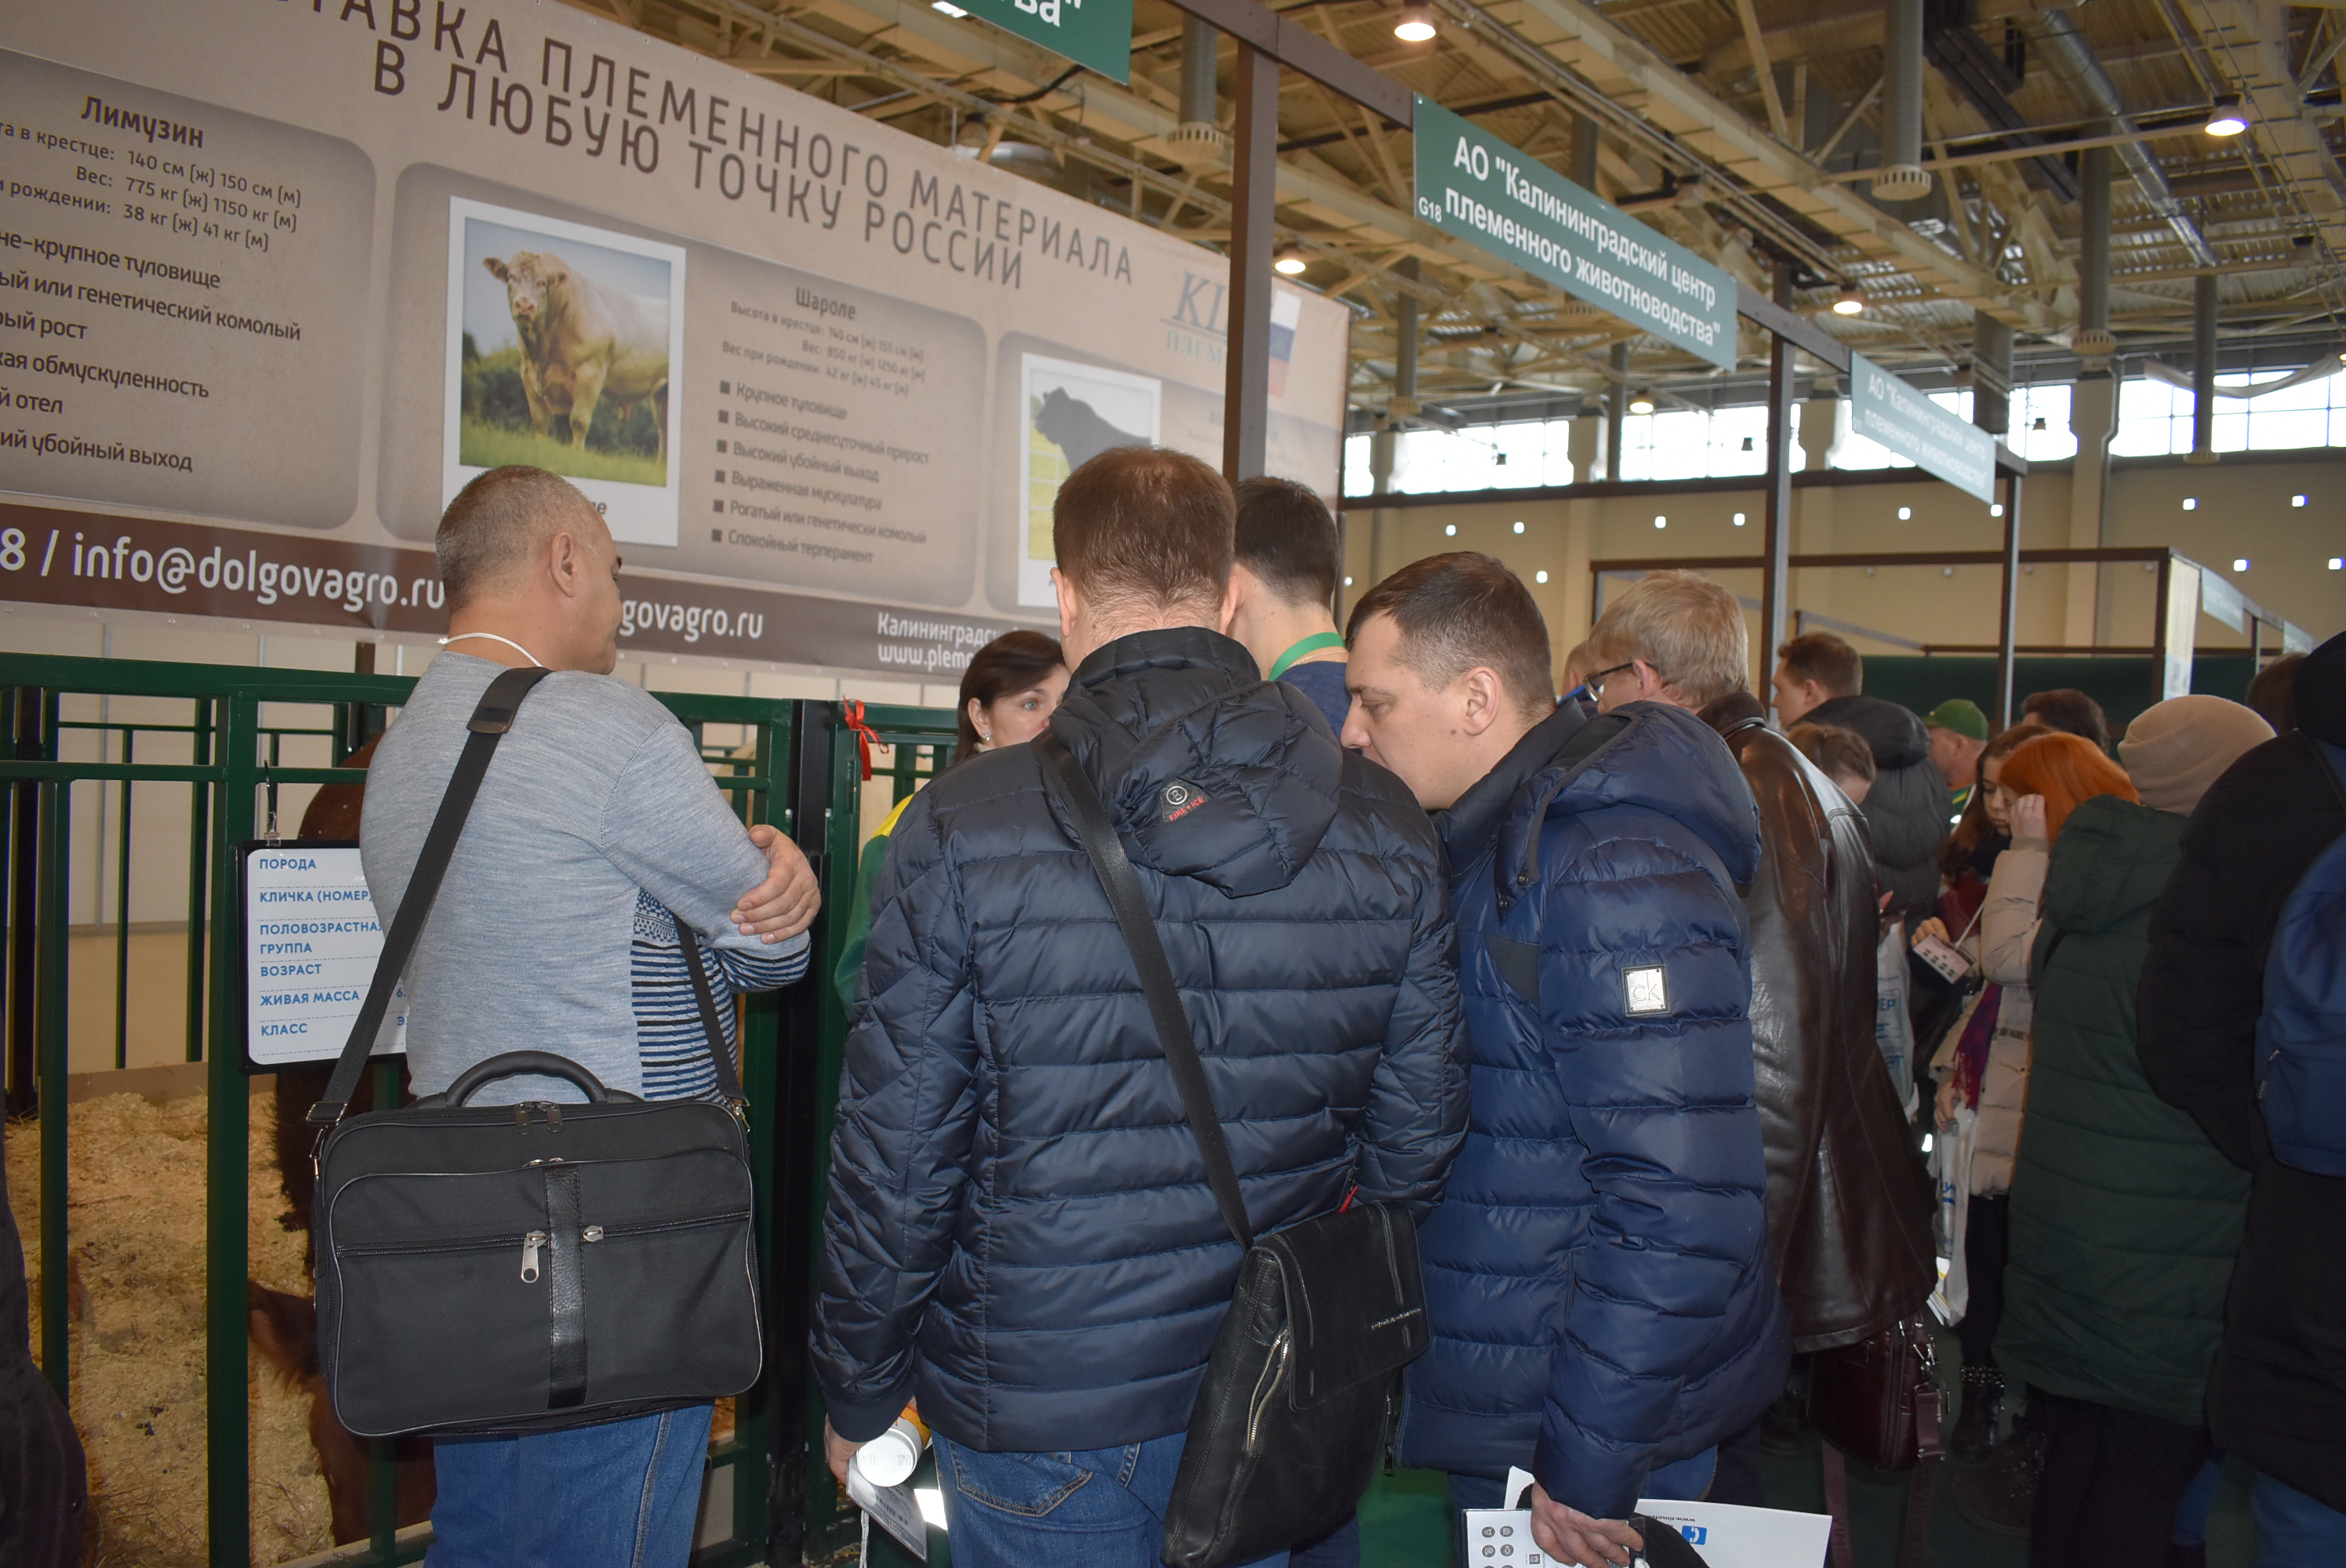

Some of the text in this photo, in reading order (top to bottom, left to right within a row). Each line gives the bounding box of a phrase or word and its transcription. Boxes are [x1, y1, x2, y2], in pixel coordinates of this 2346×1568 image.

[81, 96, 204, 148] Лимузин
[20, 128, 31, 140] в
[37, 132, 114, 160] крестце:
[128, 151, 158, 169] 140
[163, 162, 184, 177] см
[220, 173, 247, 191] 150
[252, 183, 272, 198] см
[374, 39, 1022, 289] В ЛЮБУЮ ТОЧКУ РОССИИ
[541, 37, 888, 197] ПЛЕМЕННОГО
[910, 169, 1131, 285] МАТЕРИАЛА
[76, 165, 113, 187] Вес:
[125, 176, 155, 197] 775
[160, 187, 178, 201] кг
[213, 198, 248, 218] 1150
[252, 209, 269, 223] кг
[1418, 196, 1442, 223] G18
[10, 182, 111, 215] рождении:
[123, 204, 145, 221] 38
[151, 212, 168, 226] кг
[203, 222, 220, 238] 41
[224, 229, 241, 242] кг
[1453, 135, 1716, 311] АО "Калининградский центр
[124, 255, 221, 289] туловище
[1445, 187, 1720, 347] племенного животноводства"
[34, 278, 73, 299] или
[78, 285, 212, 325] генетический
[216, 311, 301, 341] комолый
[796, 286, 856, 320] Шароле
[40, 318, 88, 339] рост
[32, 354, 209, 398] обмускуленность
[16, 394, 64, 414] отел
[736, 382, 788, 408] Крупное
[735, 411, 788, 437] Высокий
[32, 433, 125, 462] убойный
[129, 447, 193, 473] выход
[733, 441, 787, 465] Высокий
[730, 499, 781, 523] Рогатый
[0, 528, 445, 613] 8 / info@dolgovagro.ru
[260, 858, 316, 871] ПОРОДА
[260, 891, 314, 902] КЛИЧКА
[260, 942, 312, 955] ГРУППА
[260, 964, 321, 977] ВОЗРАСТ
[260, 990, 360, 1006] ЖИВАЯ МАССА
[261, 1023, 308, 1036] КЛАСС
